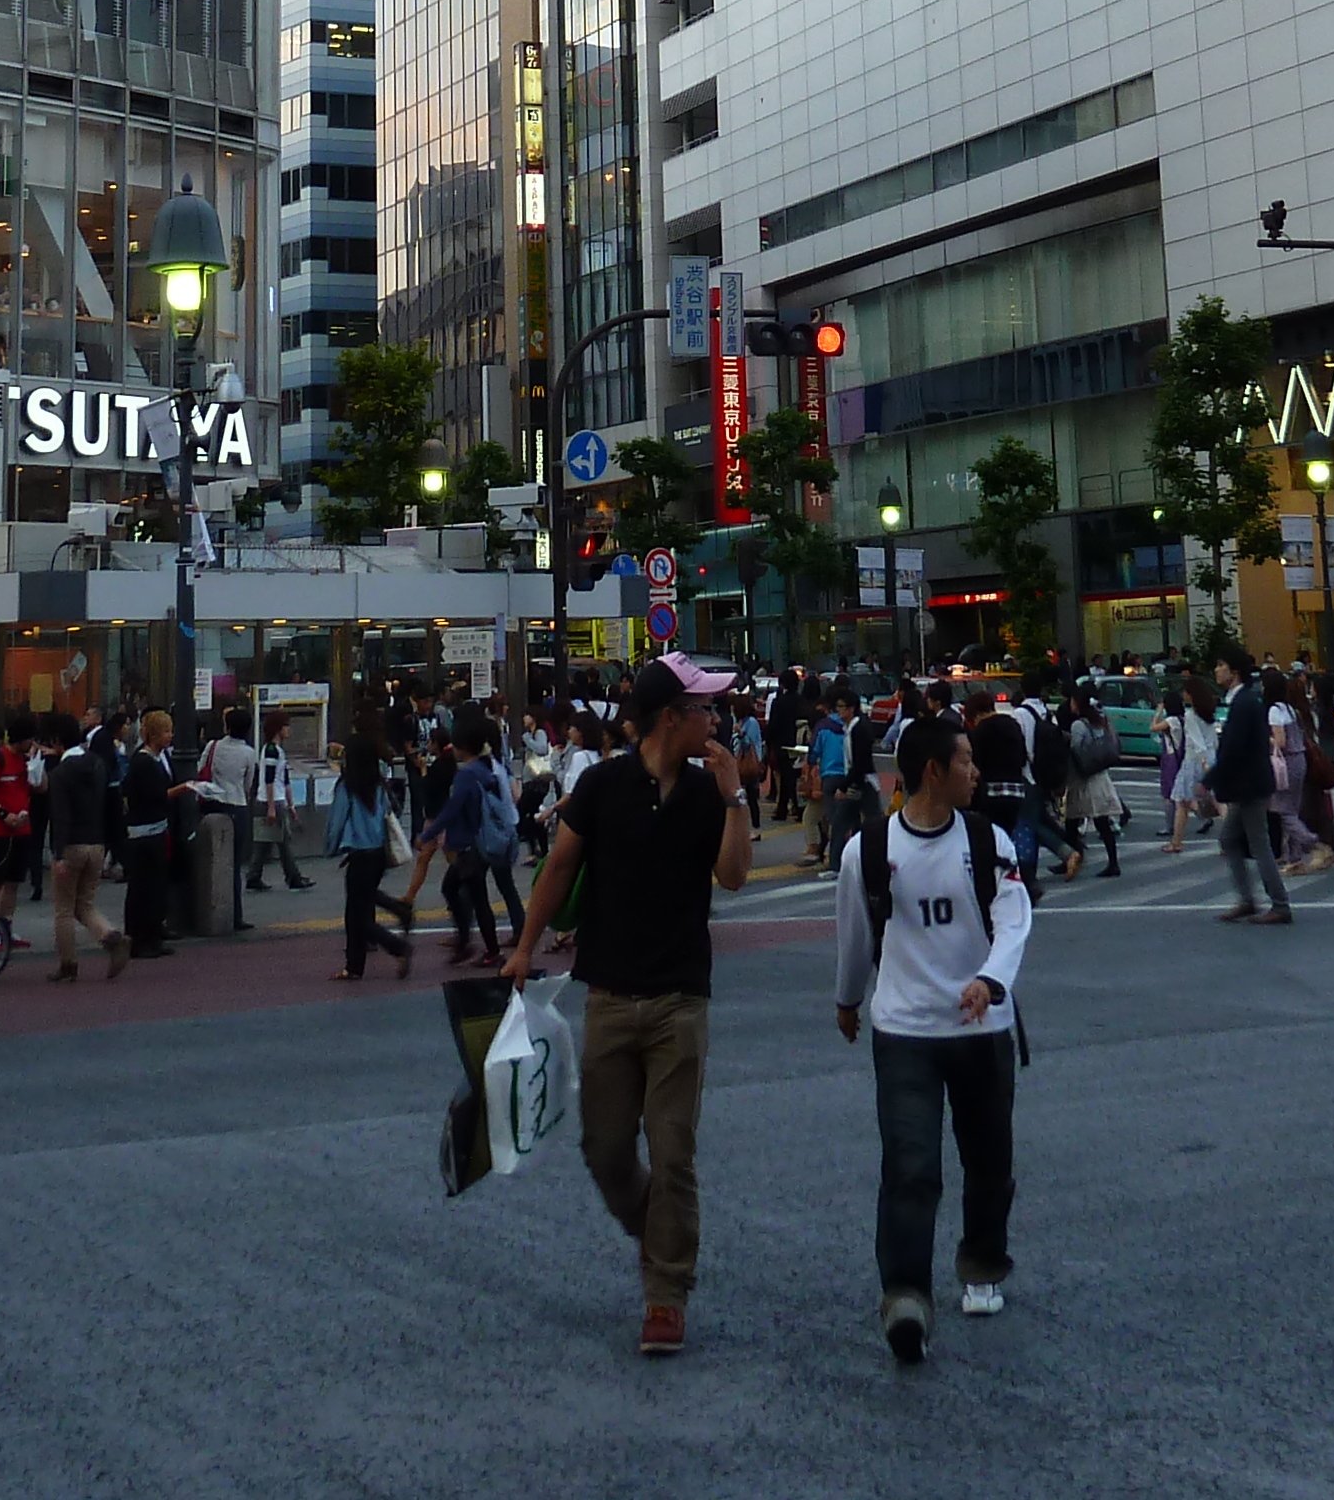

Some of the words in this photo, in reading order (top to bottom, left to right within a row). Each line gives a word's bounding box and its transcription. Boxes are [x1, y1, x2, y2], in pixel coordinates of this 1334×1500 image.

[674, 277, 685, 315] Shibuya
[687, 264, 703, 348] 渋谷駅前
[918, 897, 953, 928] 10
